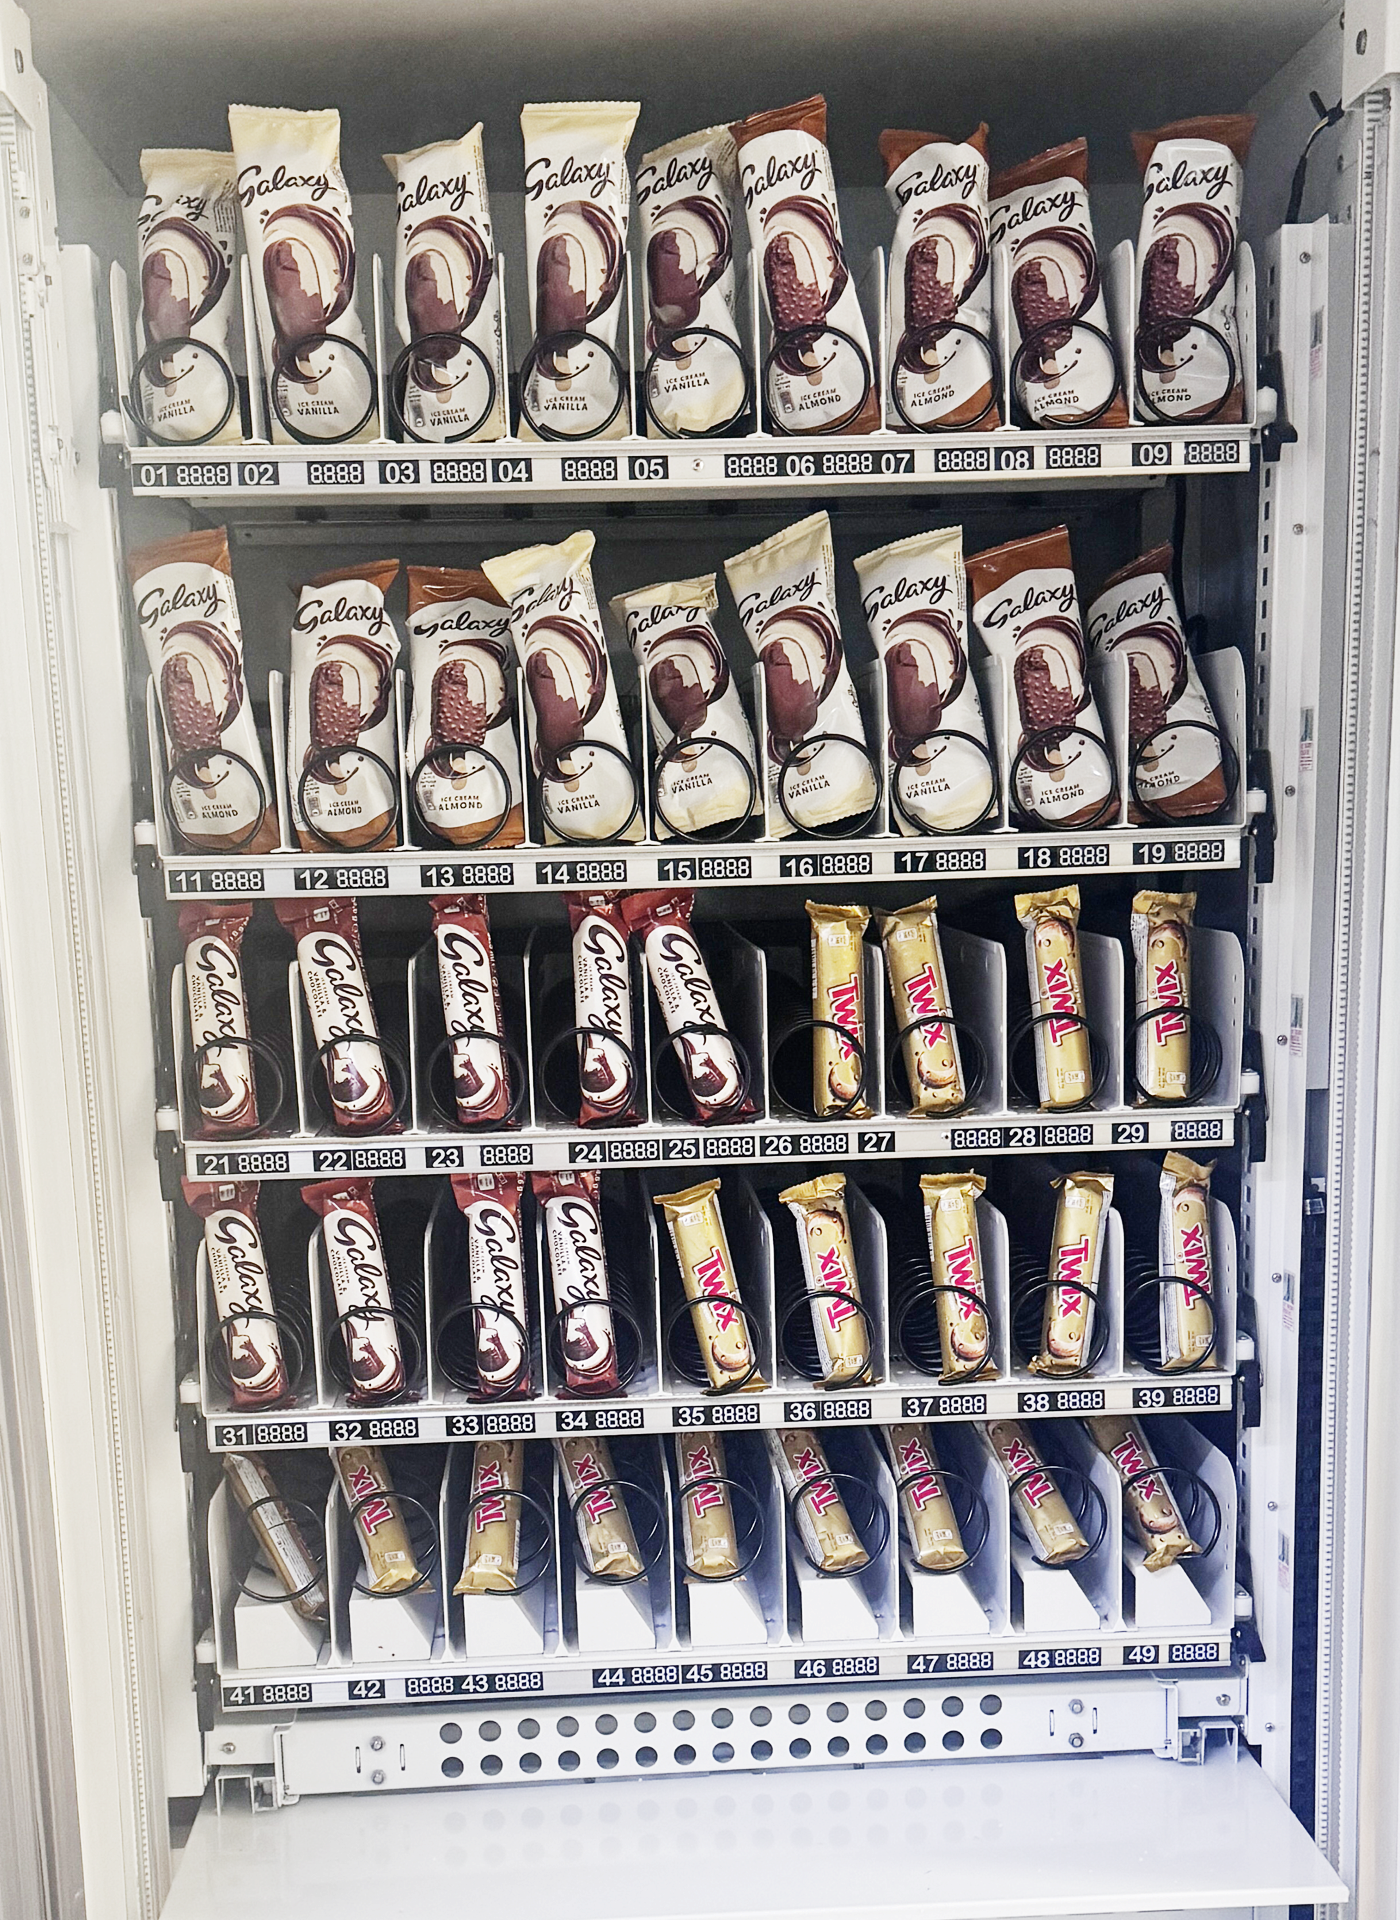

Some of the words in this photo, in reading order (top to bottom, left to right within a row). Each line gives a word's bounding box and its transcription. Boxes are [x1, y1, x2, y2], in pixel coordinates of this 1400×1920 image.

[237, 165, 336, 207] Galaxy
[523, 156, 612, 200] Galaxy
[636, 157, 715, 206] Galaxy
[742, 151, 817, 209] Galaxy
[895, 163, 980, 206] Galaxy
[1143, 160, 1233, 202] Galaxy
[397, 172, 474, 216] alaxy
[989, 190, 1084, 243] Galaxy
[663, 378, 711, 393] VANILLA
[927, 384, 952, 397] CREAM
[543, 403, 589, 411] VANILLA
[797, 394, 840, 412] ALMOND
[910, 390, 955, 408] ALMOND
[296, 406, 340, 416] VANILLA
[428, 414, 469, 427] VANILLA
[1001, 451, 1029, 469] 08
[1140, 444, 1167, 464] 09
[385, 464, 414, 483] 03
[499, 461, 528, 480] 04
[634, 460, 663, 479] 05
[786, 456, 815, 475] 06
[881, 455, 909, 474] 07
[141, 466, 167, 486] 01
[244, 464, 274, 485] 02
[137, 581, 225, 628] Galaxy
[738, 570, 822, 626] Galaxy
[863, 573, 952, 623] Galaxy
[982, 584, 1077, 629] Galaxy
[293, 597, 391, 635] Galaxy
[413, 611, 512, 637] Galaxy
[1087, 586, 1171, 648] Galaxy
[788, 780, 831, 799] VANILLA
[905, 783, 951, 799] VANILLA
[920, 777, 946, 787] CREAM
[1055, 783, 1080, 794] CREAM
[571, 794, 595, 804] CREAM
[1039, 788, 1085, 805] ALMOND
[327, 806, 362, 817] ALMOND
[438, 801, 483, 811] ALMOND
[557, 800, 601, 814] VANILLA
[902, 853, 928, 871] 17
[1024, 848, 1050, 867] 18
[1139, 844, 1165, 863] 19
[542, 865, 570, 883] 14
[664, 862, 691, 880] 15
[786, 858, 813, 876] 16
[176, 872, 201, 891] 11
[300, 870, 328, 889] 12
[426, 868, 454, 886] 13
[440, 932, 486, 1047] Galaxy
[583, 924, 627, 1043] Galaxy
[196, 943, 240, 1058] Galaxy
[311, 938, 365, 1050] Galaxy
[864, 1133, 891, 1151] 27
[1010, 1128, 1035, 1146] 28
[1118, 1124, 1144, 1142] 29
[575, 1145, 602, 1162] 24
[669, 1140, 696, 1158] 25
[766, 1136, 792, 1154] 26
[205, 1156, 229, 1174] 21
[320, 1154, 347, 1170] 22
[432, 1149, 460, 1167] 23
[474, 1208, 518, 1322] Galaxy
[557, 1202, 602, 1313] Galaxy
[214, 1216, 265, 1328] Galaxy
[334, 1217, 385, 1331] Galaxy
[908, 1399, 933, 1416] 37
[1023, 1396, 1049, 1411] 38
[1139, 1391, 1164, 1407] 39
[562, 1412, 588, 1429] 34
[679, 1407, 704, 1425] 35
[790, 1403, 816, 1420] 36
[335, 1424, 362, 1440] 32
[453, 1416, 479, 1434] 33
[223, 1427, 246, 1444] 31
[1023, 1651, 1050, 1668] 48
[1129, 1647, 1155, 1662] 49
[799, 1660, 826, 1677] 46
[912, 1656, 939, 1672] 47
[598, 1669, 625, 1685] 44
[686, 1665, 713, 1682] 45
[354, 1682, 381, 1698] 42
[462, 1676, 488, 1693] 43
[230, 1687, 254, 1704] 41
